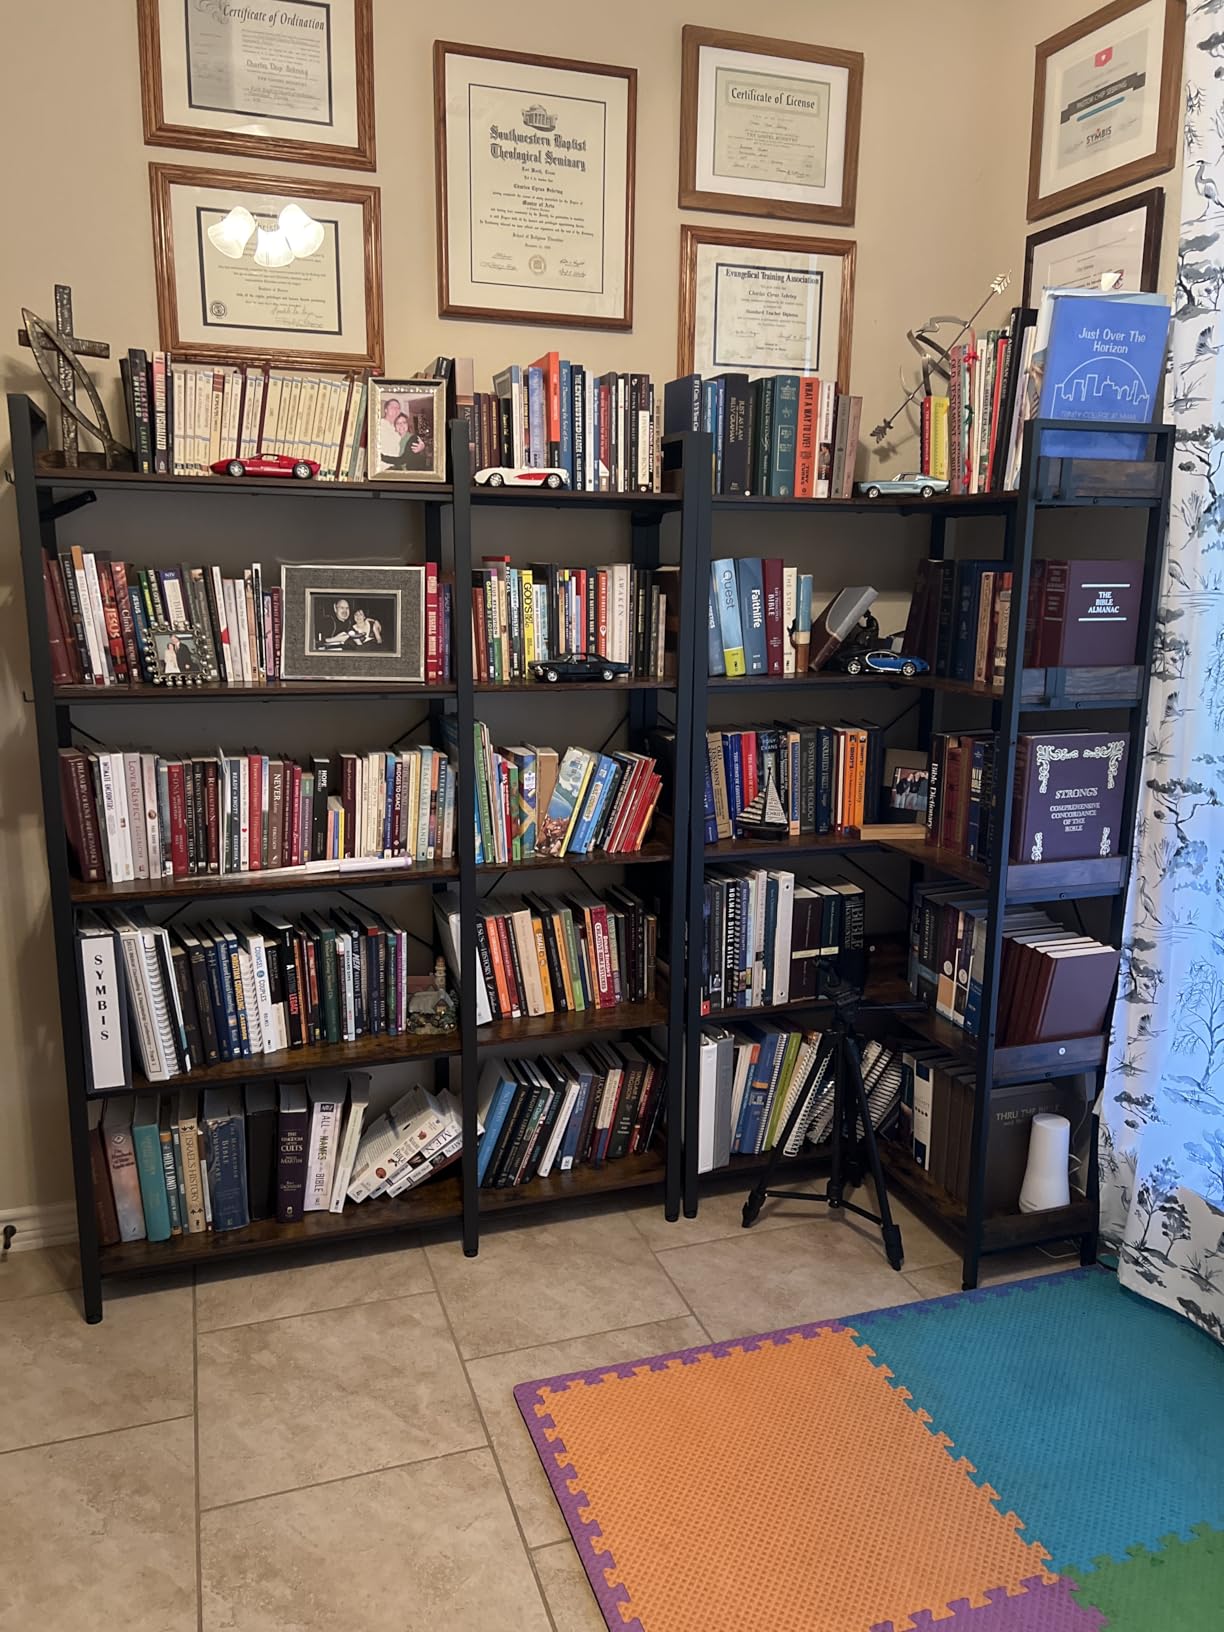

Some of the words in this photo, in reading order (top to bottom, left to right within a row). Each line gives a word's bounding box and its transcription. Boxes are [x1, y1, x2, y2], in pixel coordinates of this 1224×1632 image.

[223, 5, 266, 23] Certificate
[268, 10, 278, 27] of
[280, 13, 325, 30] Ordination
[732, 88, 772, 103] Certificate
[775, 93, 784, 104] of
[786, 95, 815, 109] License
[490, 124, 550, 146] Southwestern
[554, 134, 586, 151] Baptist
[1086, 126, 1112, 144] SYMBIS
[490, 143, 541, 164] Theological
[545, 151, 585, 172] Seminary
[726, 269, 759, 279] Evangelical
[761, 272, 784, 283] Training
[786, 275, 819, 284] Association
[1079, 328, 1099, 339] Just
[1103, 329, 1125, 341] Over
[1130, 331, 1145, 343] The
[1093, 341, 1128, 353] Horizon
[133, 376, 141, 417] UNVEILED
[140, 372, 148, 422] REVELATION
[155, 374, 165, 412] REVELATION
[804, 382, 814, 400] WHAT
[738, 417, 745, 426] AS
[802, 421, 811, 430] TO
[803, 408, 812, 420] WAY
[156, 413, 166, 450] VISUALIZED
[737, 430, 744, 440] AM
[801, 432, 810, 448] LIVE!
[523, 583, 533, 613] GOD'S
[721, 569, 738, 610] Quest
[132, 594, 141, 614] JESUS
[751, 589, 763, 628] Faithlife
[106, 606, 121, 639] JESUS
[122, 609, 132, 633] Christ
[103, 761, 111, 782] INTIMATE
[711, 747, 720, 786] TESTAMENT
[104, 784, 114, 810] ENCOUNTERS
[421, 763, 429, 817] PEACEMAKER
[1055, 788, 1097, 799] STRONGS
[926, 787, 936, 829] Dictionary
[1050, 803, 1100, 812] COMPREHENSIVE
[1052, 810, 1096, 819] CONCORDANCE
[851, 907, 864, 950] BIBLE
[536, 933, 544, 953] SMALL
[231, 953, 240, 980] CHRISTIAN
[254, 946, 264, 969] COUNSEL
[480, 948, 492, 976] HISTORY
[94, 955, 109, 1040] SYMBIS
[234, 980, 243, 1010] COUNSELING
[258, 979, 268, 1002] COUPLES
[289, 993, 299, 1015] LEGACY
[320, 1115, 330, 1128] ALL
[532, 1107, 542, 1121] Days
[996, 1111, 1018, 1120] THRU
[186, 1137, 195, 1168] ISRAEL'S
[222, 1140, 230, 1165] BIBLE
[317, 1135, 328, 1160] NAMES
[164, 1152, 174, 1170] HOLY
[167, 1172, 176, 1190] LAND
[188, 1170, 198, 1203] HISTORY
[315, 1173, 325, 1193] BIBLE
